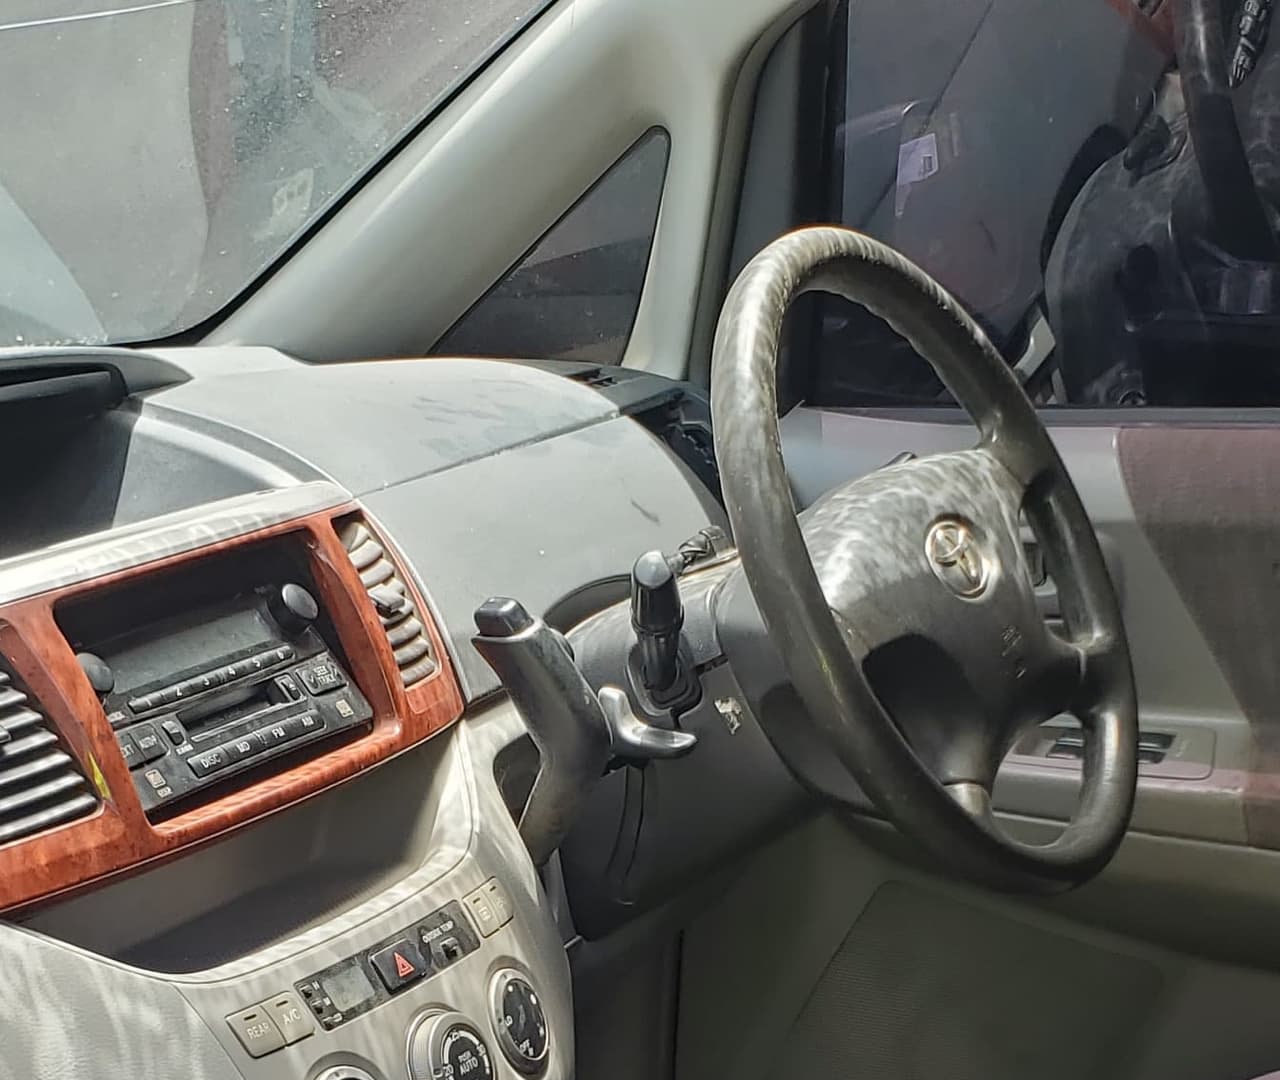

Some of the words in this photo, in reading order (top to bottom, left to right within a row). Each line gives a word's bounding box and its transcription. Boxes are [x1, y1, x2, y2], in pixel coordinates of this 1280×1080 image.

[271, 726, 286, 739] FM
[200, 752, 223, 769] DISC
[282, 1008, 301, 1026] A/C
[246, 1022, 270, 1040] REAR
[459, 1056, 479, 1076] AUTO
